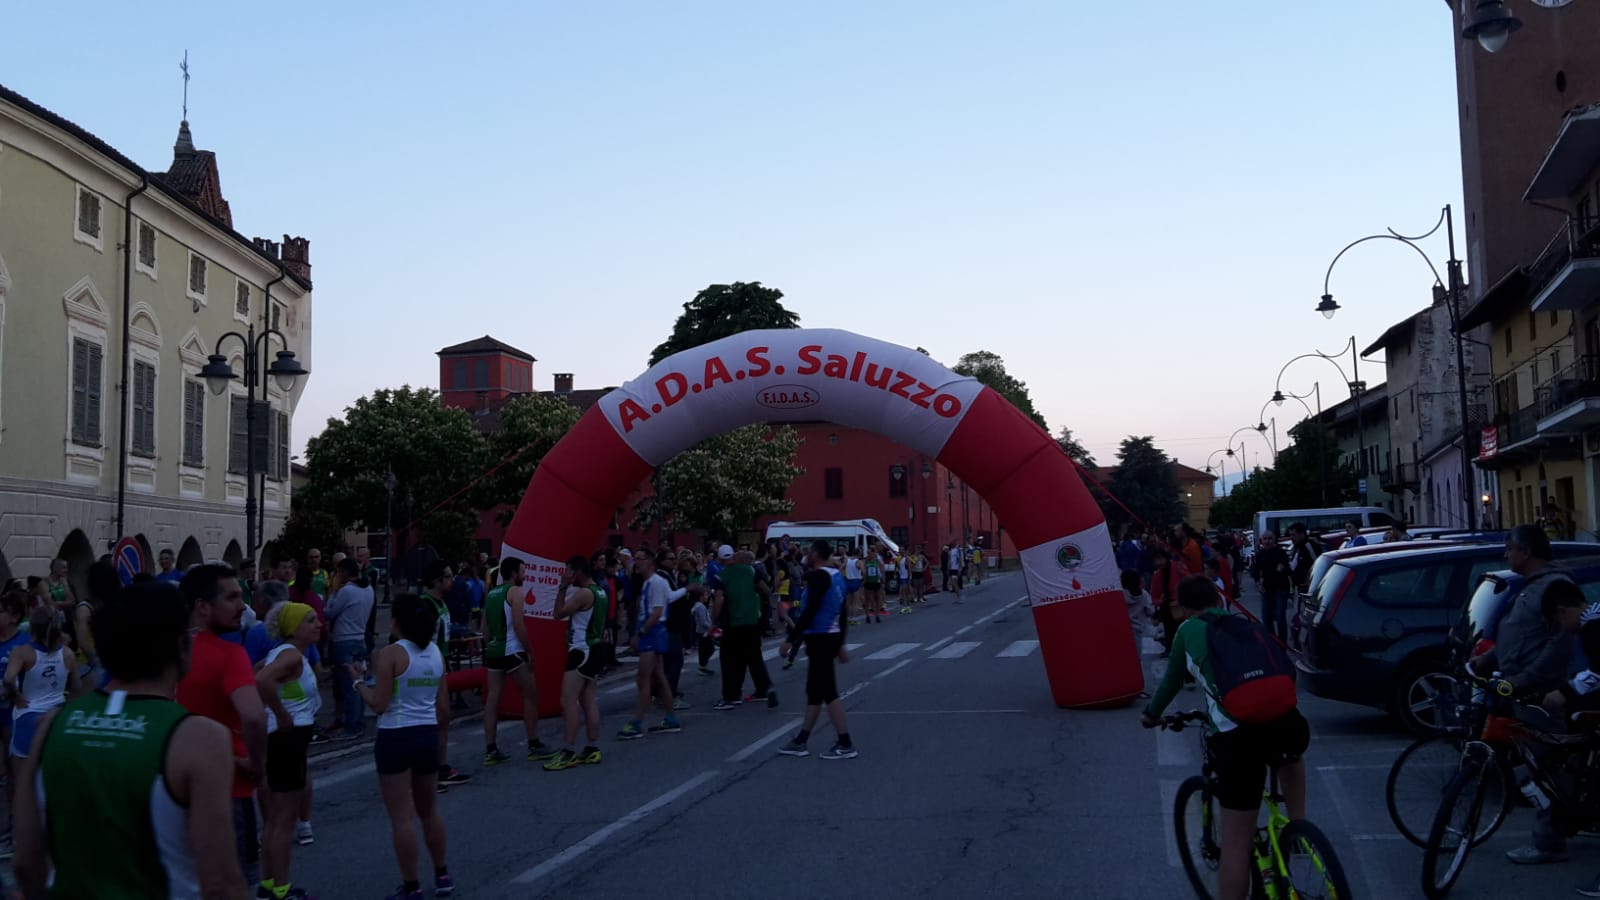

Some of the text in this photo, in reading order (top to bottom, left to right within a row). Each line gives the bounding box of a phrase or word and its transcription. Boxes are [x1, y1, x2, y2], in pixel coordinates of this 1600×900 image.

[618, 345, 962, 431] A.D.A.S. Saluzzo
[763, 392, 814, 404] F.I.D.A.S.
[538, 577, 558, 585] vita
